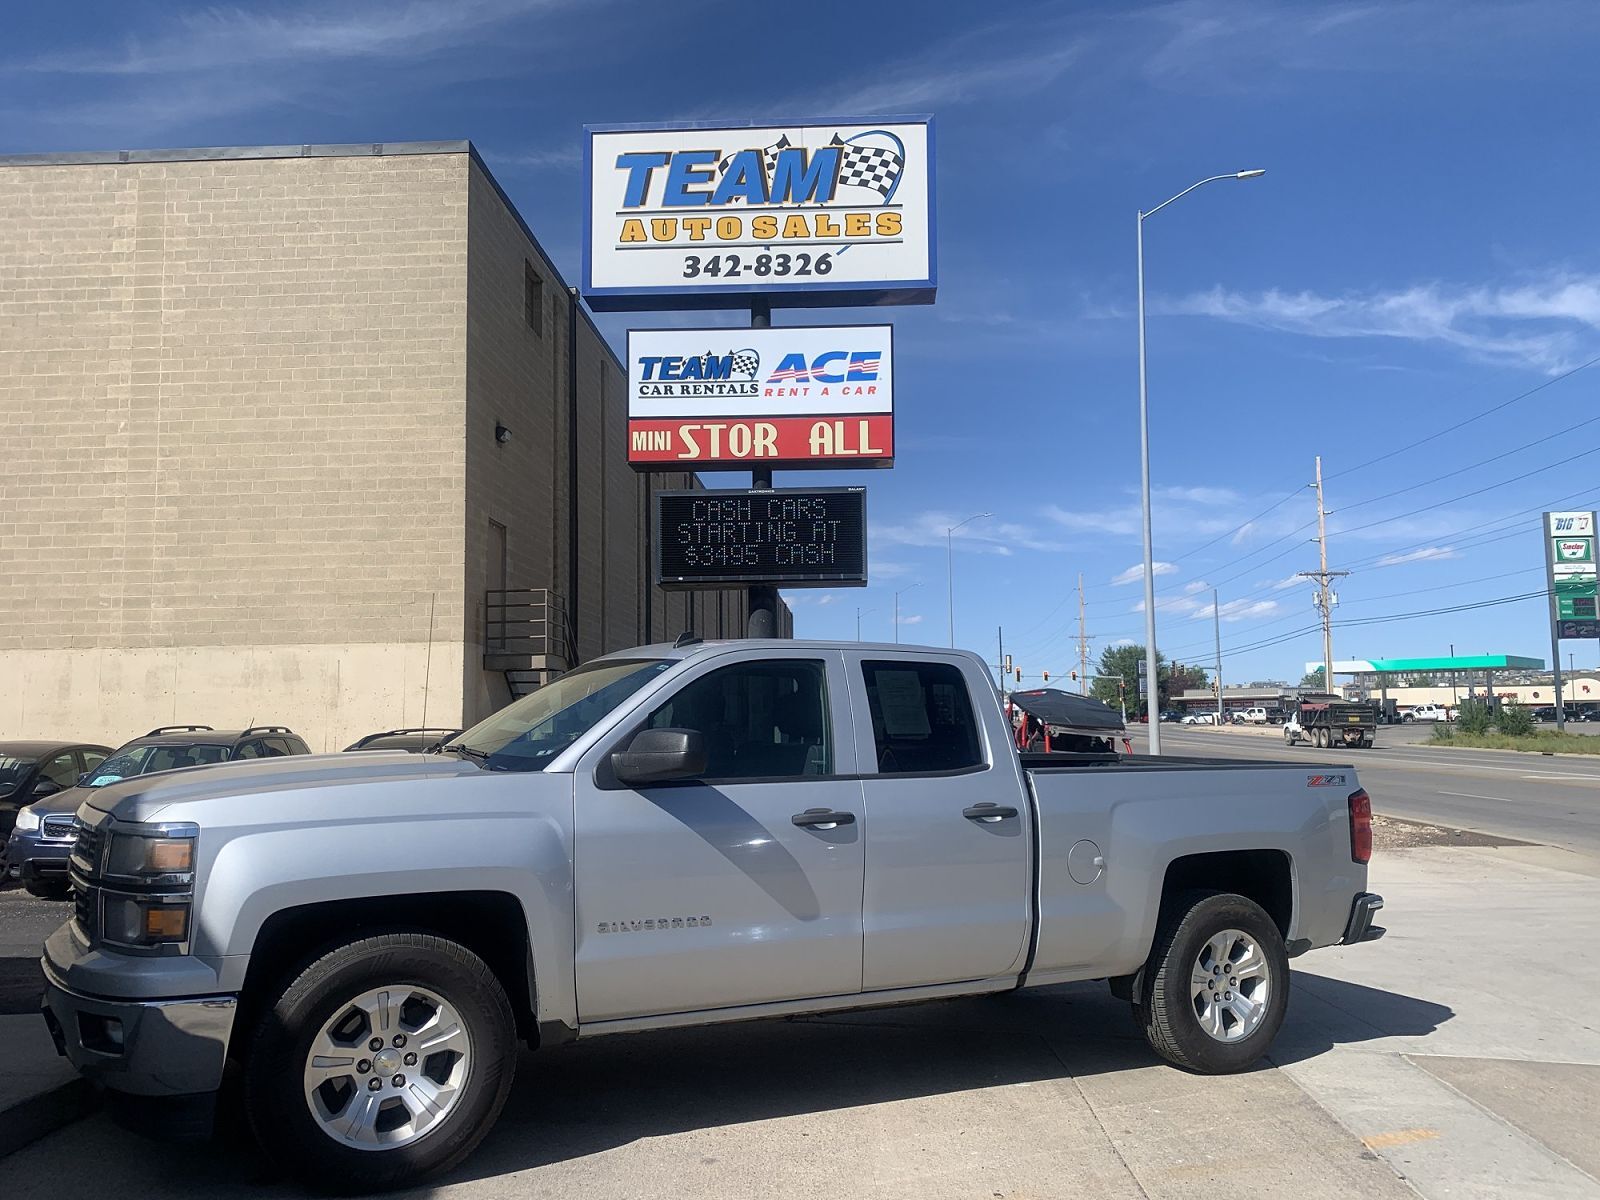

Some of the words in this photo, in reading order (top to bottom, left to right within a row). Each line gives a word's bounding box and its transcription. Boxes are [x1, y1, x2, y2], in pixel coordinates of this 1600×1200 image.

[614, 145, 844, 209] TEAM
[619, 216, 743, 242] AUTO
[751, 212, 903, 240] SALES
[682, 252, 833, 278] 342-8326
[638, 355, 735, 381] TEAM
[765, 350, 883, 384] ACE
[639, 383, 674, 396] CAR
[680, 382, 759, 396] RENTALS
[764, 387, 810, 397] RENT
[820, 386, 830, 396] A
[842, 386, 878, 396] CAR
[632, 430, 671, 452] MINI
[677, 421, 779, 459] STOR
[809, 419, 883, 456] ALL
[692, 499, 751, 521] CASH
[767, 498, 826, 520] CARS
[678, 521, 797, 544] STARTING
[812, 520, 841, 541] AT
[1555, 517, 1574, 530] BIG
[685, 544, 759, 566] $3495
[775, 543, 834, 565] CASH
[597, 915, 712, 934] SILVERADO
